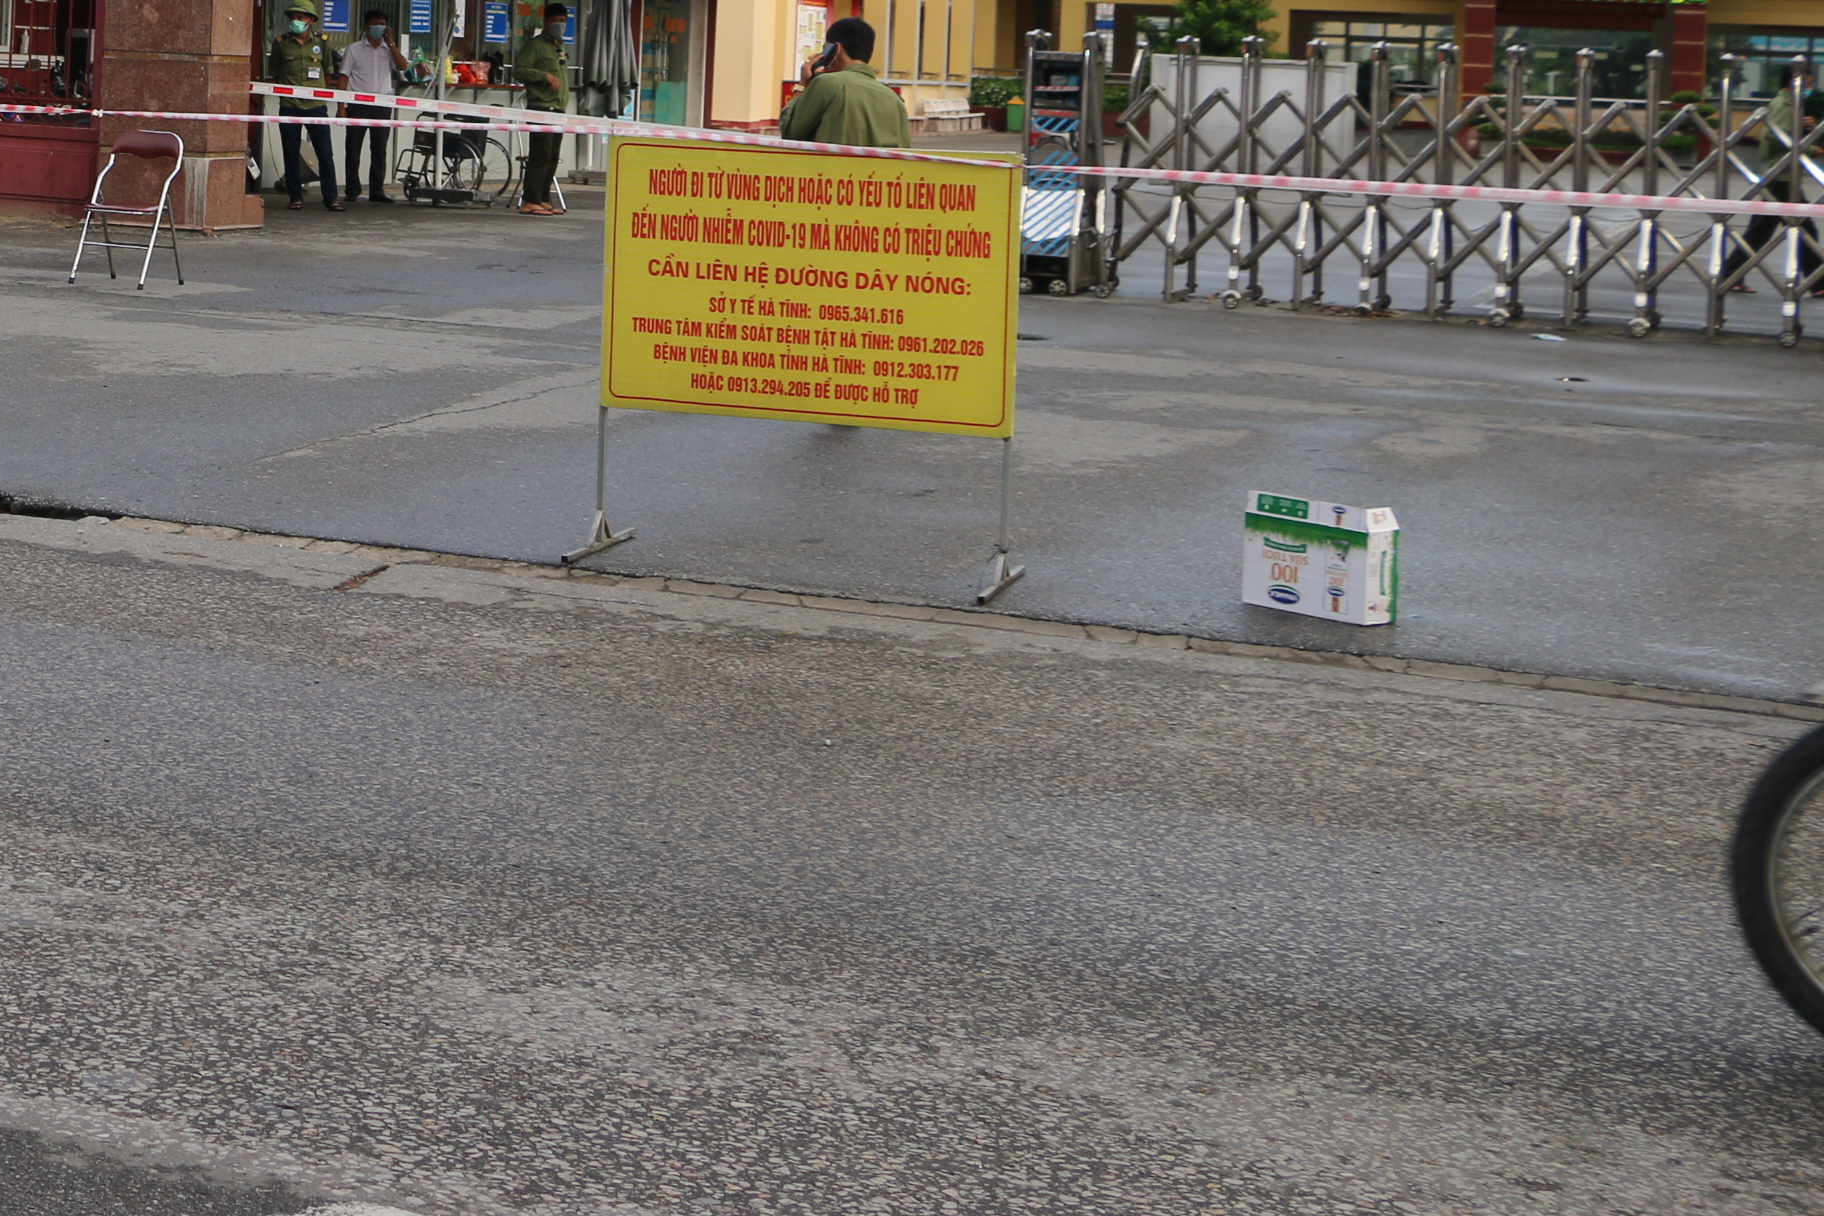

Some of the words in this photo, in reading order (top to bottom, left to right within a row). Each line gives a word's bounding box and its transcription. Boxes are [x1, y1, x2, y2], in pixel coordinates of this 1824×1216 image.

[649, 163, 687, 197] NGƯỜI
[691, 171, 704, 198] ĐI
[708, 166, 725, 199] TỪ
[727, 168, 760, 201] VÙNG
[764, 175, 794, 208] DỊCH
[798, 172, 833, 211] HOẶC
[837, 174, 854, 206] CÓ
[858, 171, 883, 208] YẾU
[887, 172, 904, 209] TỐ
[906, 177, 936, 210] LIÊN
[940, 183, 976, 214] QUAN
[631, 203, 657, 239] ĐẾN
[660, 208, 699, 242] NGƯỜI
[702, 207, 744, 245] NHIỄM
[748, 219, 806, 249] COVID-19
[810, 218, 831, 251] MÀ
[834, 219, 879, 253] KHÔNG
[883, 221, 901, 254] CÓ
[905, 223, 942, 262] TRIỆU
[946, 222, 991, 259] CHỨNG
[648, 252, 690, 278] CẦN
[696, 259, 738, 282] LIÊN
[744, 261, 769, 289] HỆ
[774, 264, 849, 289] ĐƯỜNG
[855, 268, 899, 292] DÂY
[905, 271, 972, 296] NÓNG:
[709, 291, 727, 313] SỞ
[729, 298, 737, 314] Y
[741, 294, 756, 315] TẾ
[759, 297, 775, 317] HÀ
[819, 304, 904, 325] 0965.341.616
[632, 316, 672, 335] TRUNG
[676, 317, 702, 337] TÂM
[705, 317, 737, 340] KIỂM
[741, 323, 773, 343] SOÁT
[777, 325, 810, 348] BỆNH
[814, 327, 837, 350] TẬT
[840, 329, 857, 348] HÀ
[898, 335, 984, 357] 0961.202.026
[654, 341, 686, 364] BỆNH
[690, 345, 718, 367] VIỆN
[722, 349, 738, 366] ĐA
[742, 351, 776, 369] KHOA
[779, 348, 808, 372] TỈNH
[812, 354, 829, 373] HÀ
[873, 360, 960, 382] 0912.303.177
[691, 371, 724, 394] HOẶC
[727, 376, 811, 398] 0913.294.205
[814, 377, 832, 399] ĐỂ
[834, 384, 869, 405] ĐƯỢC
[872, 381, 890, 404] HỖ
[893, 387, 919, 409] TRỢ
